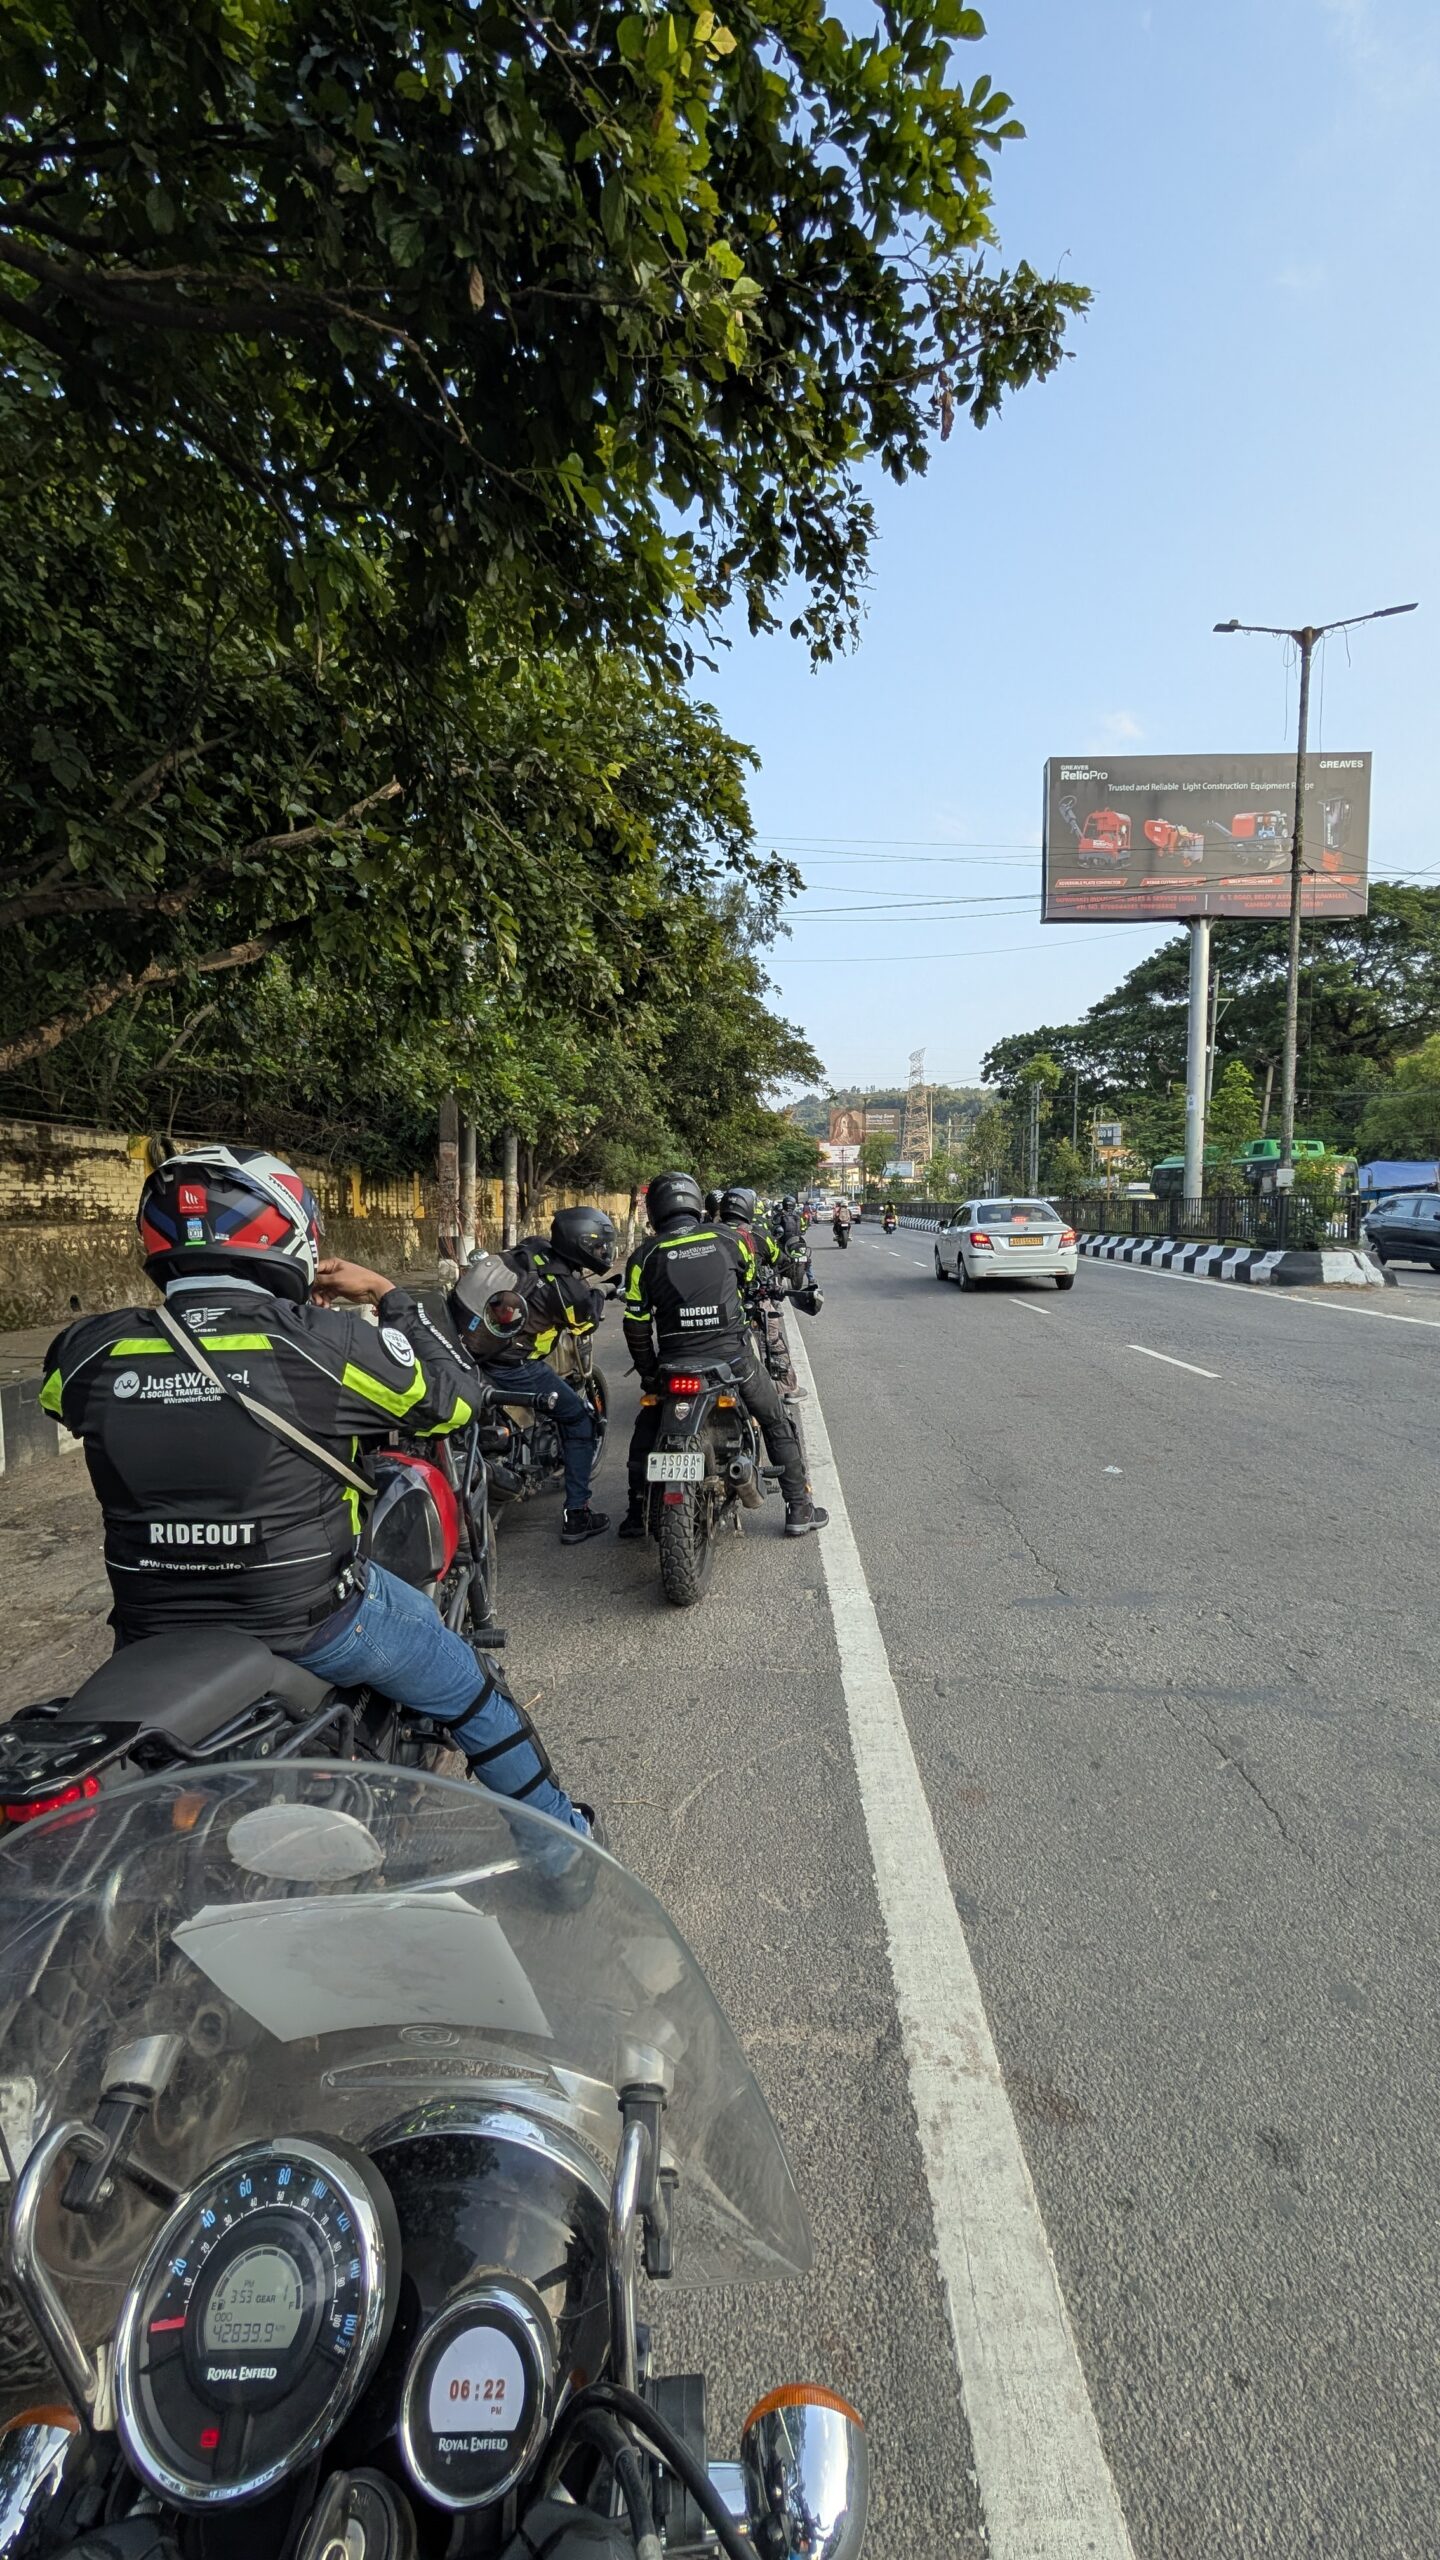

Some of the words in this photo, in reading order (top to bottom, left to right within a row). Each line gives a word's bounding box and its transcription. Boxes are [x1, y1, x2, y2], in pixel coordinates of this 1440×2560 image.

[1319, 760, 1364, 769] GREAVES
[1060, 770, 1108, 781] RelioPro
[1108, 783, 1135, 792] Trusted
[1136, 784, 1150, 792] and
[1151, 783, 1179, 791] Reliable
[1183, 783, 1201, 792] Light
[1202, 782, 1249, 791] Construction
[1250, 782, 1290, 792] Equipment
[1291, 782, 1314, 792] Rge
[680, 1305, 719, 1317] RIDEOUT
[681, 1319, 694, 1327] RIDE
[695, 1318, 703, 1326] TO
[142, 1369, 250, 1391] JustWrel
[140, 1391, 146, 1399] A
[146, 1389, 174, 1399] SOCIAL
[175, 1388, 204, 1397] TRAVEL
[661, 1455, 696, 1467] AS06A
[660, 1467, 696, 1480] F4749
[150, 1523, 255, 1546] RIDEOUT
[278, 2167, 291, 2186] 80
[239, 2178, 252, 2198] 60
[311, 2178, 329, 2200] 100
[250, 2196, 258, 2208] 40
[276, 2190, 285, 2201] 50
[300, 2196, 310, 2208] 60
[201, 2209, 216, 2228] 40
[223, 2213, 233, 2227] 30
[320, 2213, 330, 2226] 70
[336, 2211, 351, 2232] 120
[200, 2241, 210, 2254] 20
[171, 2257, 187, 2276] 20
[183, 2276, 193, 2287] 10
[255, 2294, 276, 2303] GEAR
[211, 2302, 217, 2310] E
[288, 2301, 295, 2310] F
[332, 2313, 343, 2328] 100
[343, 2313, 358, 2336] 160
[213, 2323, 274, 2343] 42839.9
[206, 2367, 238, 2381] ROYAL
[238, 2366, 278, 2381] ENFIELD
[449, 2379, 506, 2401] 06:22
[490, 2406, 502, 2415] PM
[438, 2437, 469, 2452] ROYAL
[470, 2436, 508, 2453] ENFIELD
